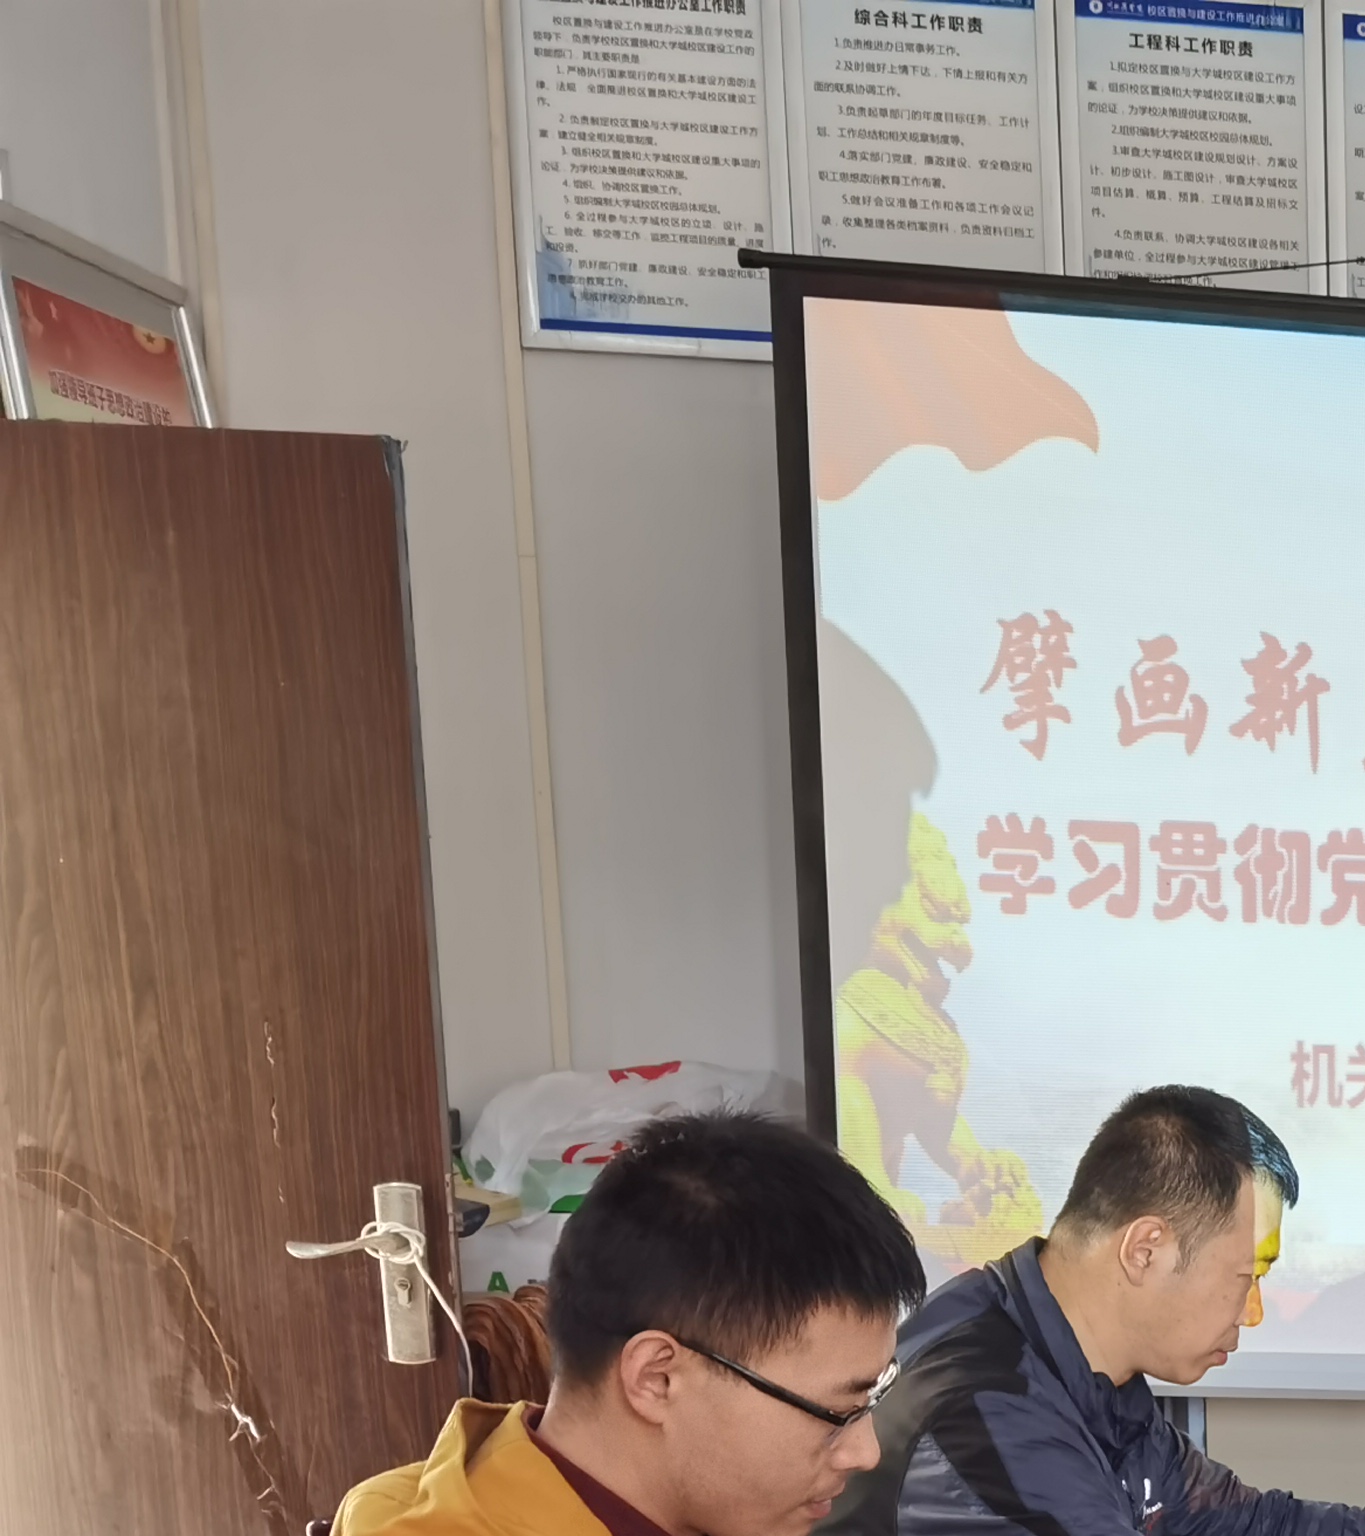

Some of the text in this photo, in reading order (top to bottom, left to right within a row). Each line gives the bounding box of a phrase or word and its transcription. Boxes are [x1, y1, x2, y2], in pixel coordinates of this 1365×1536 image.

[854, 8, 983, 34] 综合科工作职责
[1129, 33, 1253, 57] 工程科工作职责
